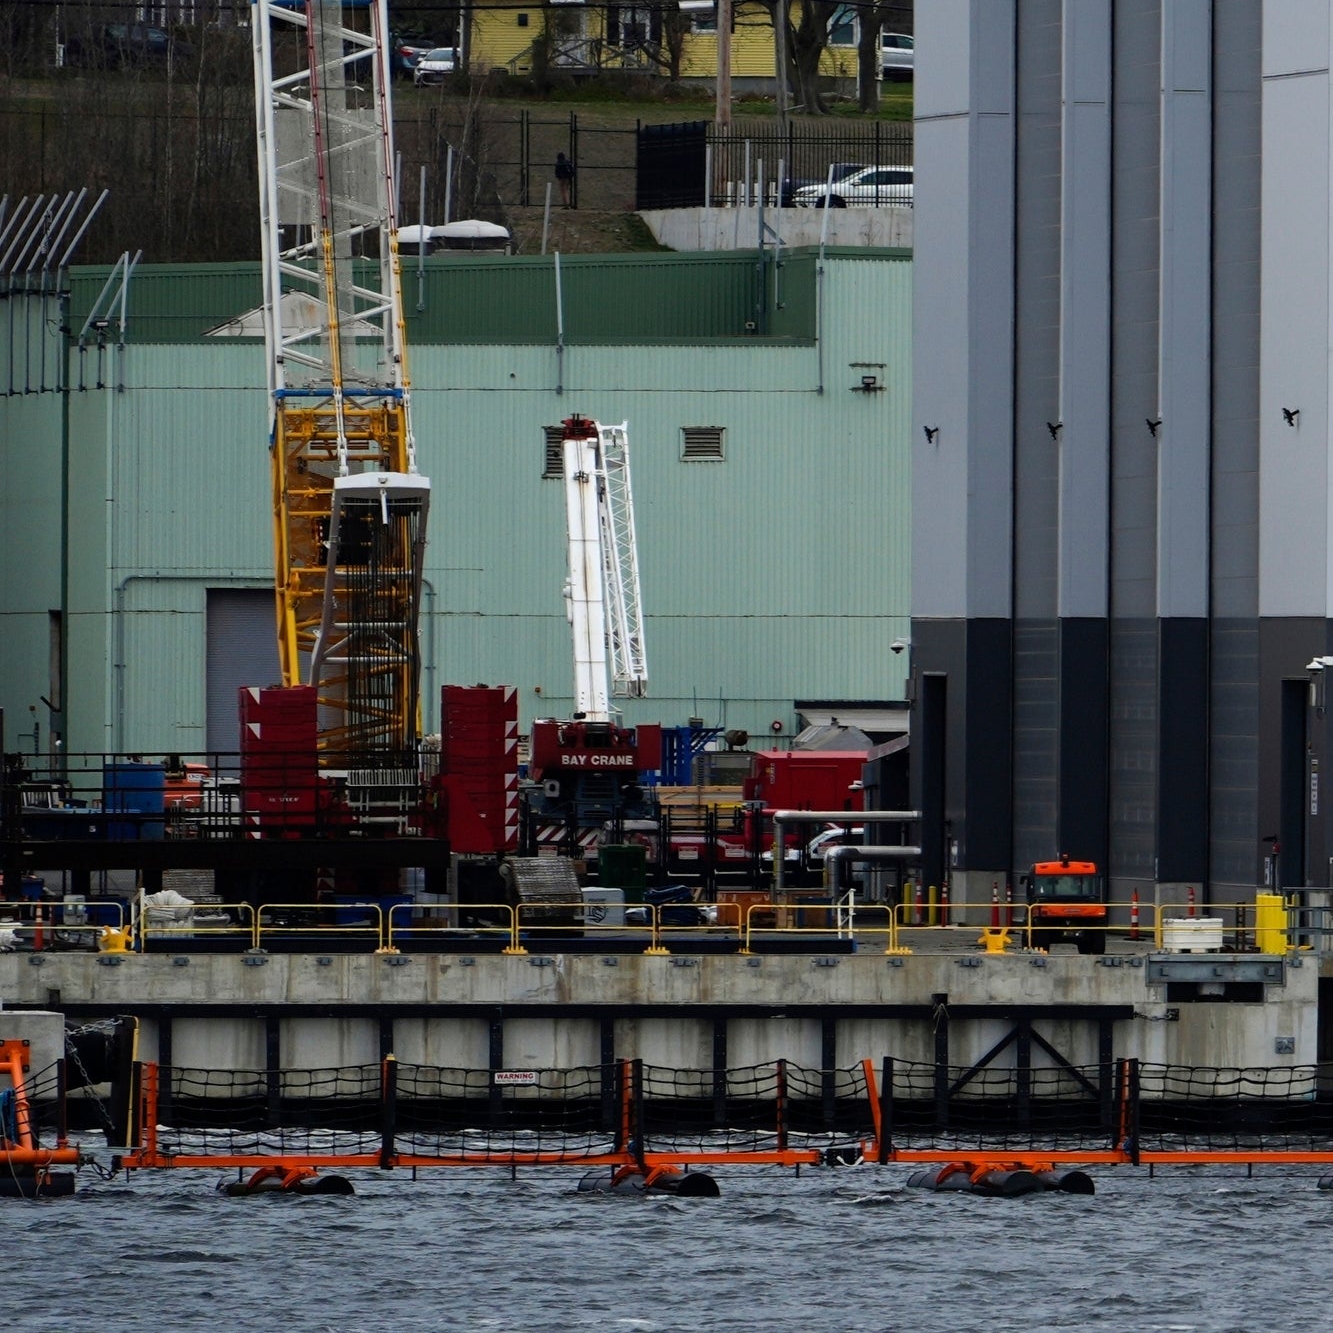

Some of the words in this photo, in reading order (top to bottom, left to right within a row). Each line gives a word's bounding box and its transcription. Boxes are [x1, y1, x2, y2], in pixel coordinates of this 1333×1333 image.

[561, 754, 587, 765] BAY
[591, 755, 634, 765] CRANE
[496, 1072, 534, 1080] WARNING
